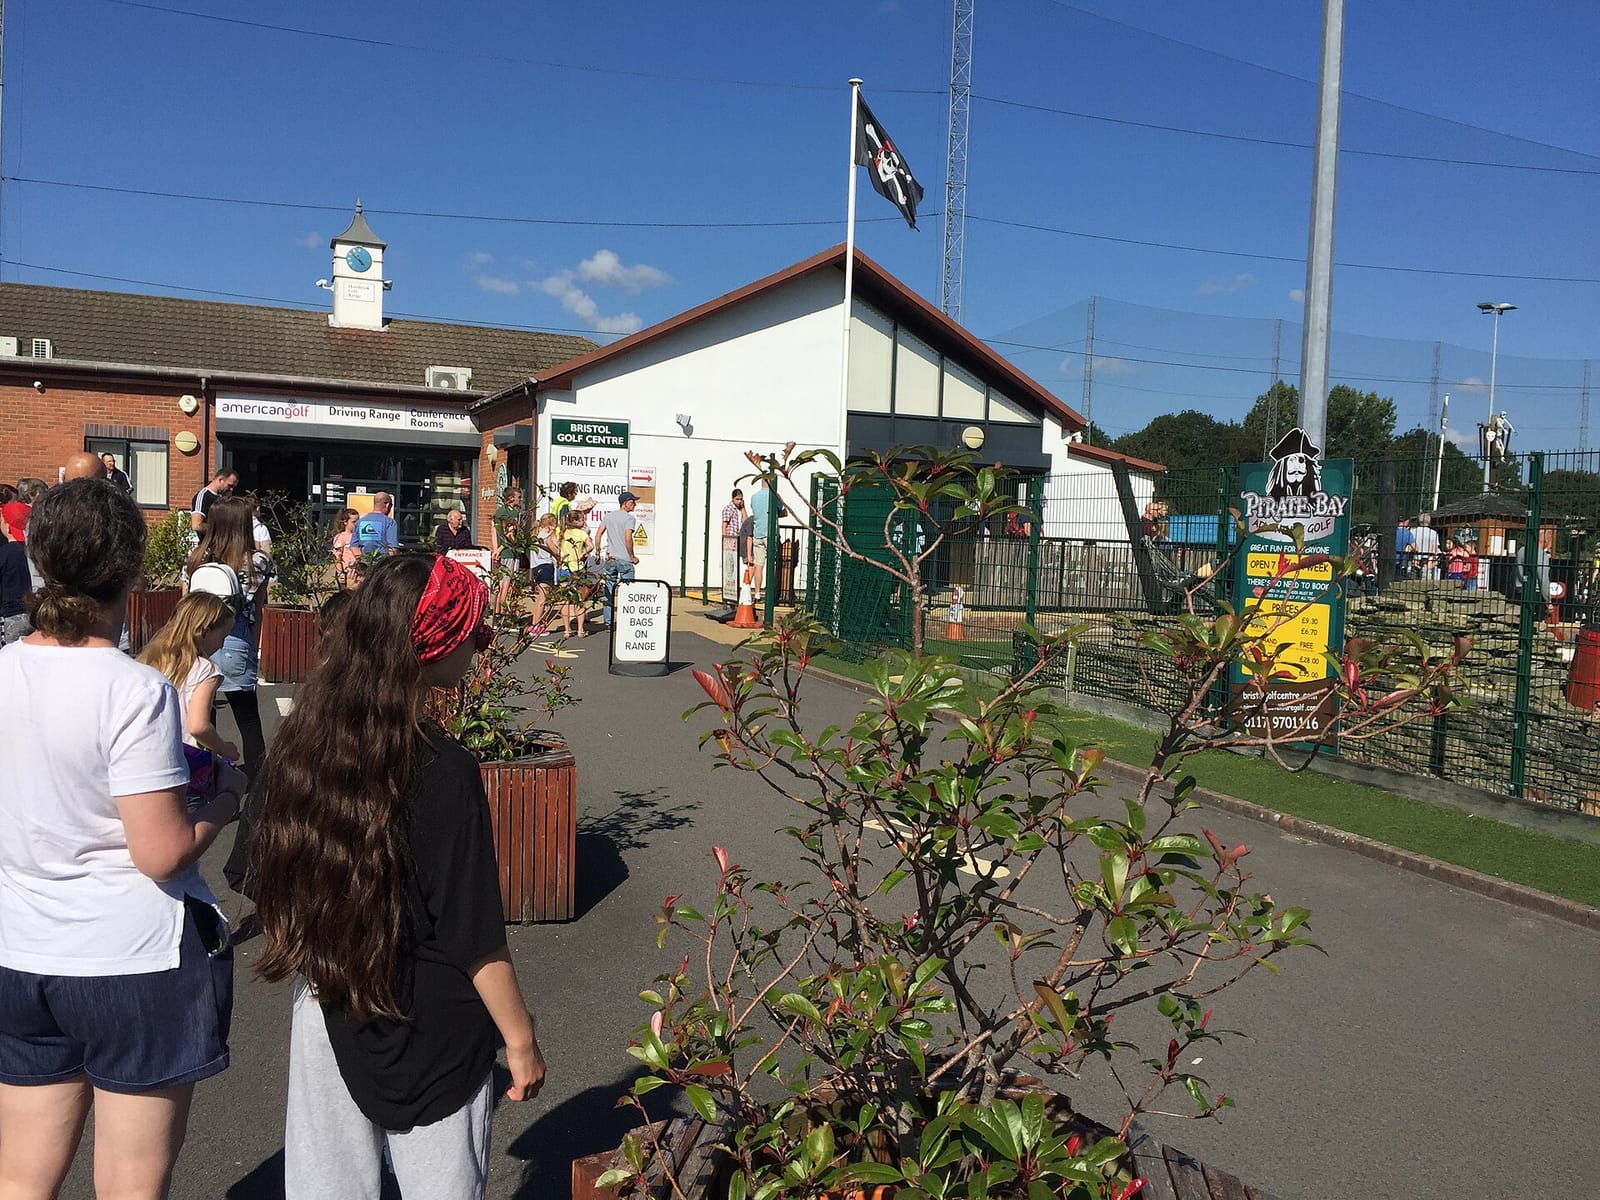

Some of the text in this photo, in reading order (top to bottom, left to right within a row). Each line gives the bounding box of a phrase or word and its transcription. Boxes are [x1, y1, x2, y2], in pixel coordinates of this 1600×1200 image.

[222, 402, 310, 419] americangolf
[329, 406, 401, 421] Driving Range
[410, 408, 466, 421] Conference
[410, 418, 444, 428] Rooms
[570, 423, 611, 434] BRISTOL
[557, 433, 624, 446] GOLF CENTRE
[560, 455, 619, 468] PIRATE BAY
[593, 484, 627, 496] RANGE
[1240, 491, 1348, 520] PIRATE BAY
[1307, 518, 1331, 534] GOLF
[1250, 544, 1269, 553] GREAT
[1269, 544, 1282, 553] FUN
[1284, 545, 1297, 553] FOR
[1250, 560, 1270, 569] OPEN
[1271, 561, 1276, 569] 7
[1247, 578, 1271, 587] THERE'S
[1283, 581, 1300, 589] NED
[628, 593, 658, 602] SORRY
[622, 606, 661, 614] NO GOLF
[1271, 603, 1299, 614] PRCES
[630, 618, 654, 626] BAGS
[634, 630, 648, 638] ON
[625, 642, 656, 650] RANGE
[1300, 641, 1314, 650] FREE
